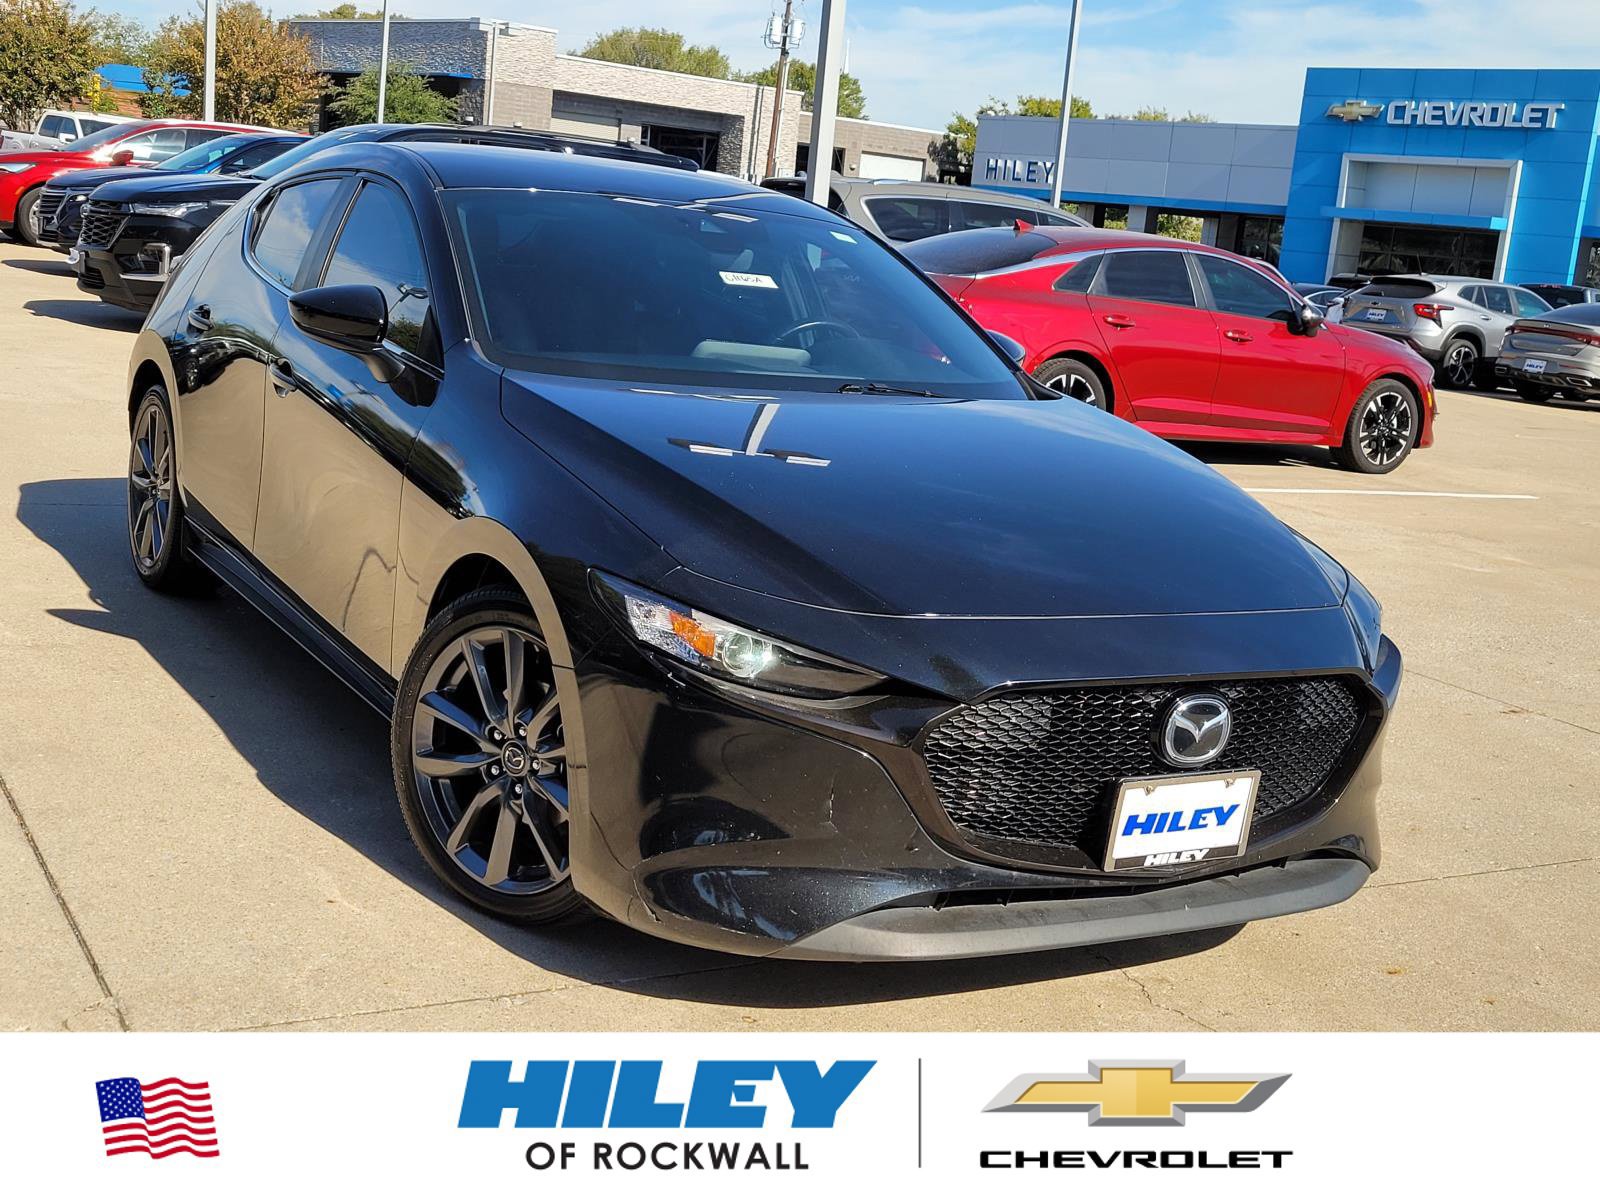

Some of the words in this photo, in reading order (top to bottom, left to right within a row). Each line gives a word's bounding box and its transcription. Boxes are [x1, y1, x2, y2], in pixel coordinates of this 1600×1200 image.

[1386, 100, 1565, 129] CHEVROLET
[985, 158, 1055, 183] HILEY
[1121, 804, 1240, 836] HILEY
[1143, 848, 1210, 867] HILEY
